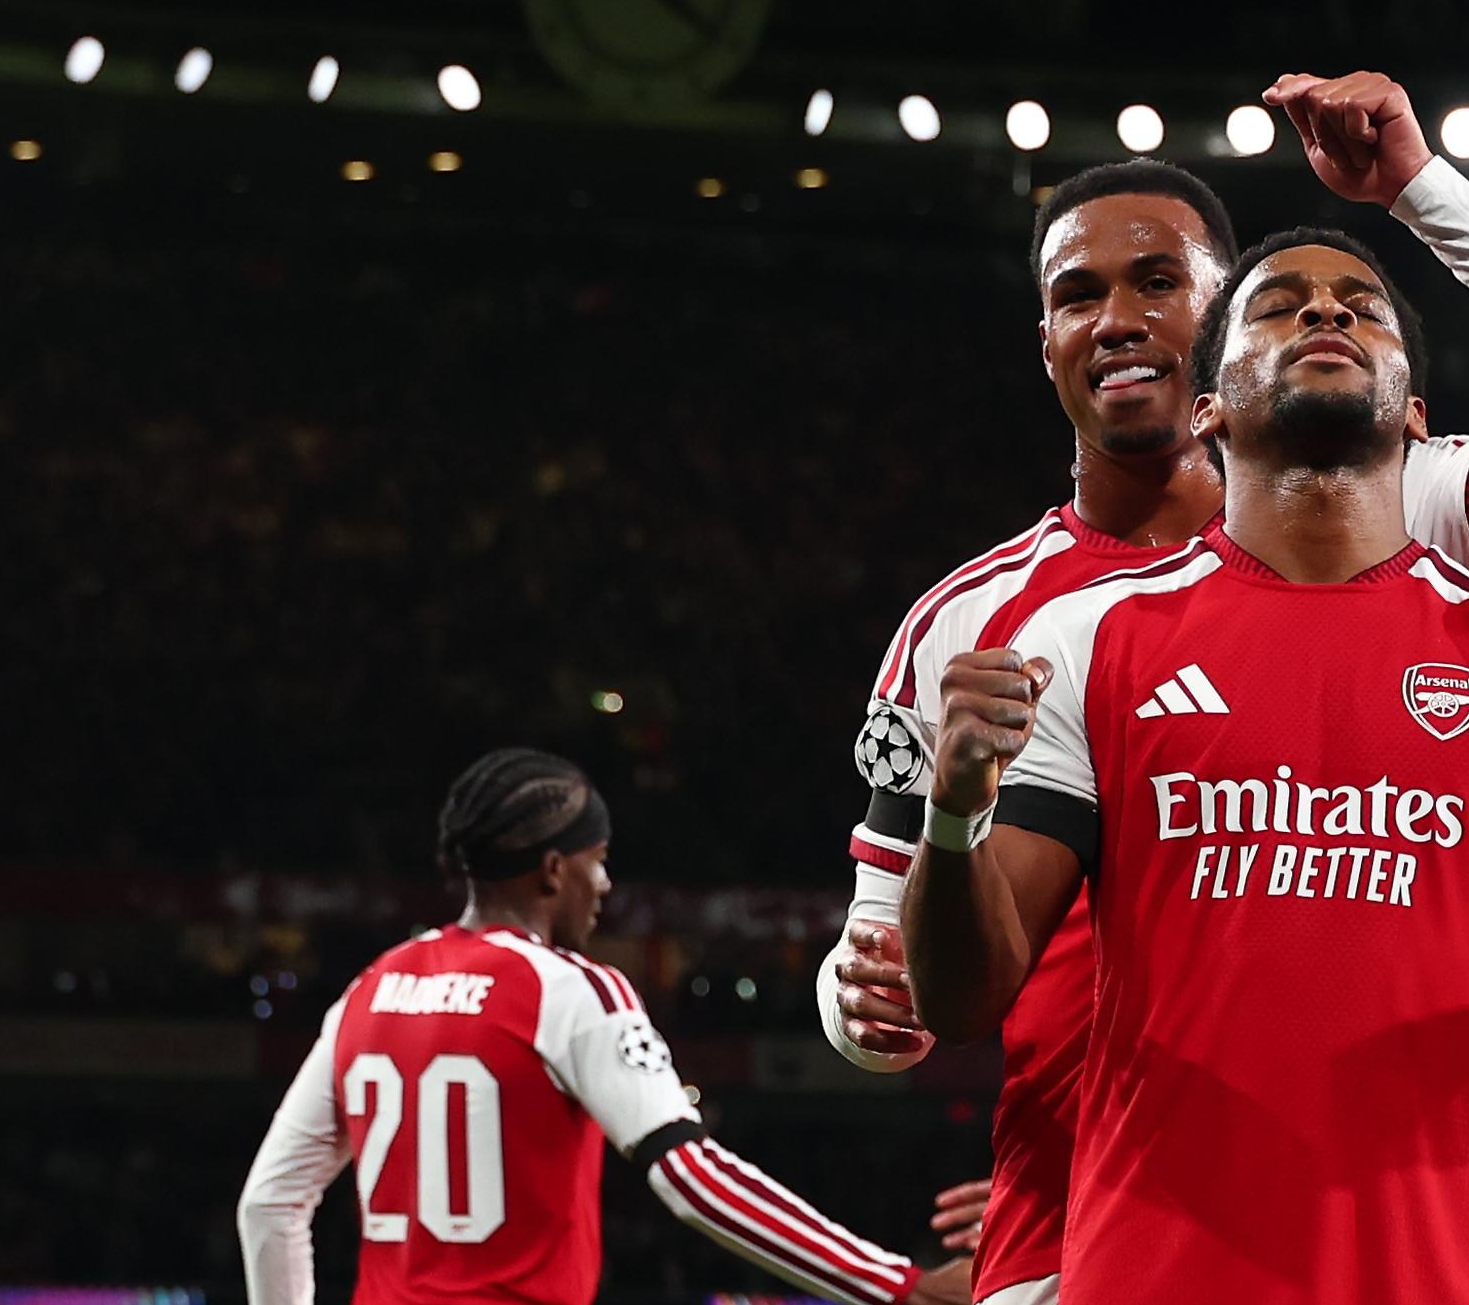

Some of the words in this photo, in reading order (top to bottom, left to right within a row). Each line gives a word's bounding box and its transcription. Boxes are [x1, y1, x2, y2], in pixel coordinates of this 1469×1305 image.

[1149, 765, 1464, 848] Emirates
[1190, 843, 1260, 900] FLY
[1267, 844, 1417, 907] BETTER
[343, 1054, 506, 1243] 20
